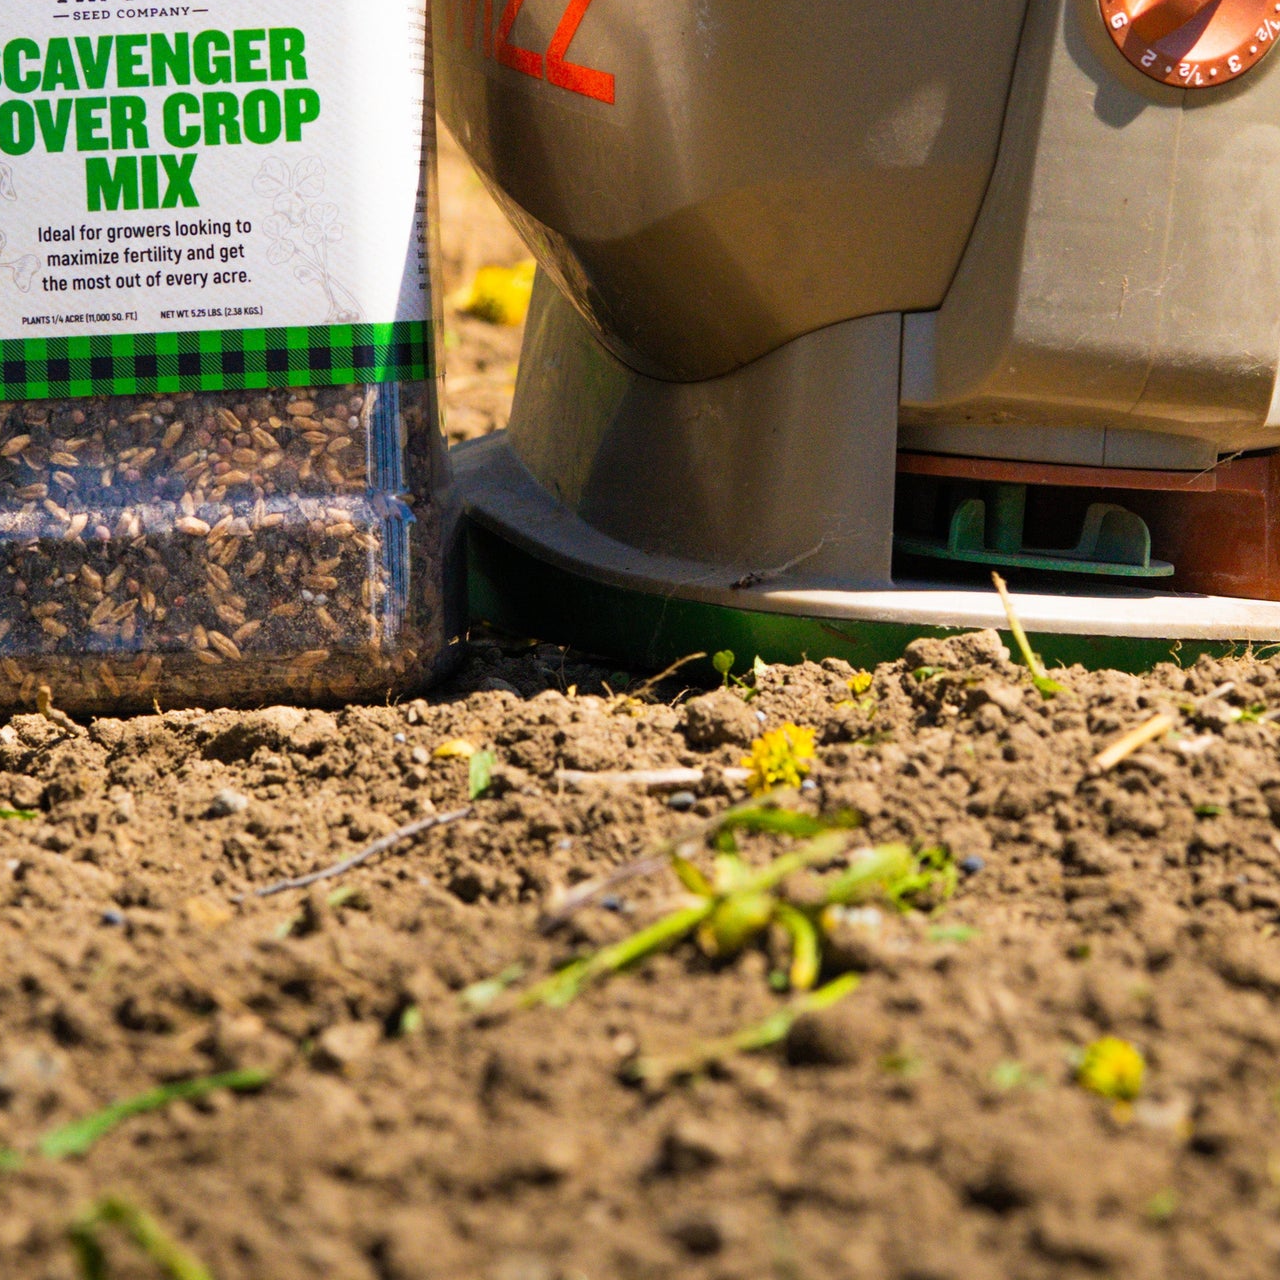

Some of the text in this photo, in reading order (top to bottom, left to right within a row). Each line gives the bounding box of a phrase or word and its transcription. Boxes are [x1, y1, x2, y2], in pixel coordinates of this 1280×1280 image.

[72, 6, 191, 21] SEED COMPANY
[1139, 48, 1158, 68] 2
[1227, 54, 1243, 73] 3
[162, 87, 321, 148] CROP
[85, 153, 201, 212] MIX
[37, 218, 252, 243] Ideal for growers looking to
[47, 243, 245, 267] maximize fertility and get
[42, 270, 252, 292] the most out of every acre.
[21, 315, 51, 325] PLANTS
[51, 313, 64, 325] 1/4
[65, 313, 85, 324] ACRE
[111, 312, 124, 322] SQ.
[160, 310, 176, 319] NET
[191, 308, 207, 318] 5.25
[207, 307, 223, 318] LBS.
